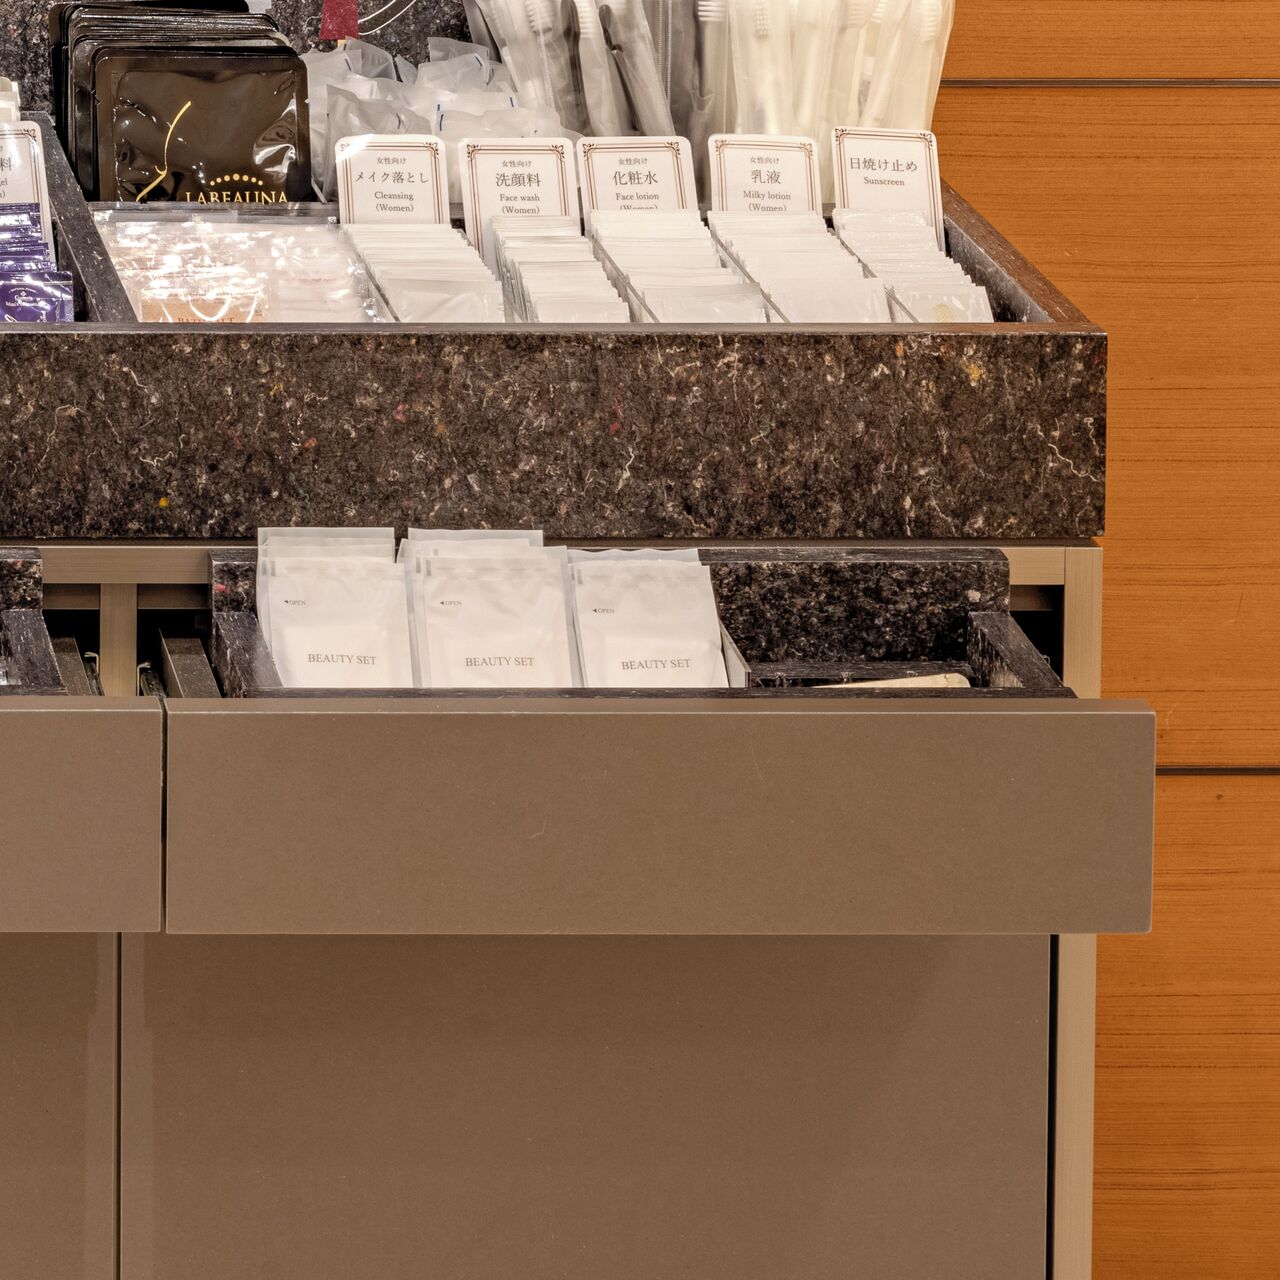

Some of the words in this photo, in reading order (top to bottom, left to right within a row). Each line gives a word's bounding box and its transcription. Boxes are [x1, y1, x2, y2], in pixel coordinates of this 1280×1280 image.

[376, 157, 406, 165] 女性向け
[502, 160, 531, 168] 女性向け
[850, 157, 918, 171] 日焼け止め
[355, 171, 429, 184] メイク落とし
[495, 172, 541, 187] 洗顔料
[613, 170, 658, 186] 化粧水
[751, 169, 782, 185] 乳液
[863, 176, 905, 186] Sunscreen
[374, 191, 414, 201] Cleansing
[500, 193, 518, 201] Face
[520, 193, 540, 201] wash
[615, 192, 634, 201] Face
[636, 192, 660, 201] lotion
[743, 190, 766, 201] Milky
[767, 191, 791, 200] lotion
[375, 203, 414, 213] (Women)
[502, 206, 540, 214] (Women)
[748, 203, 787, 212] (Women)
[308, 653, 354, 664] BEAUTY
[356, 655, 377, 665] SET
[465, 657, 512, 667] BEAUTY
[514, 656, 535, 667] SET
[621, 660, 667, 670] BEAUTY
[669, 658, 691, 669] SET
